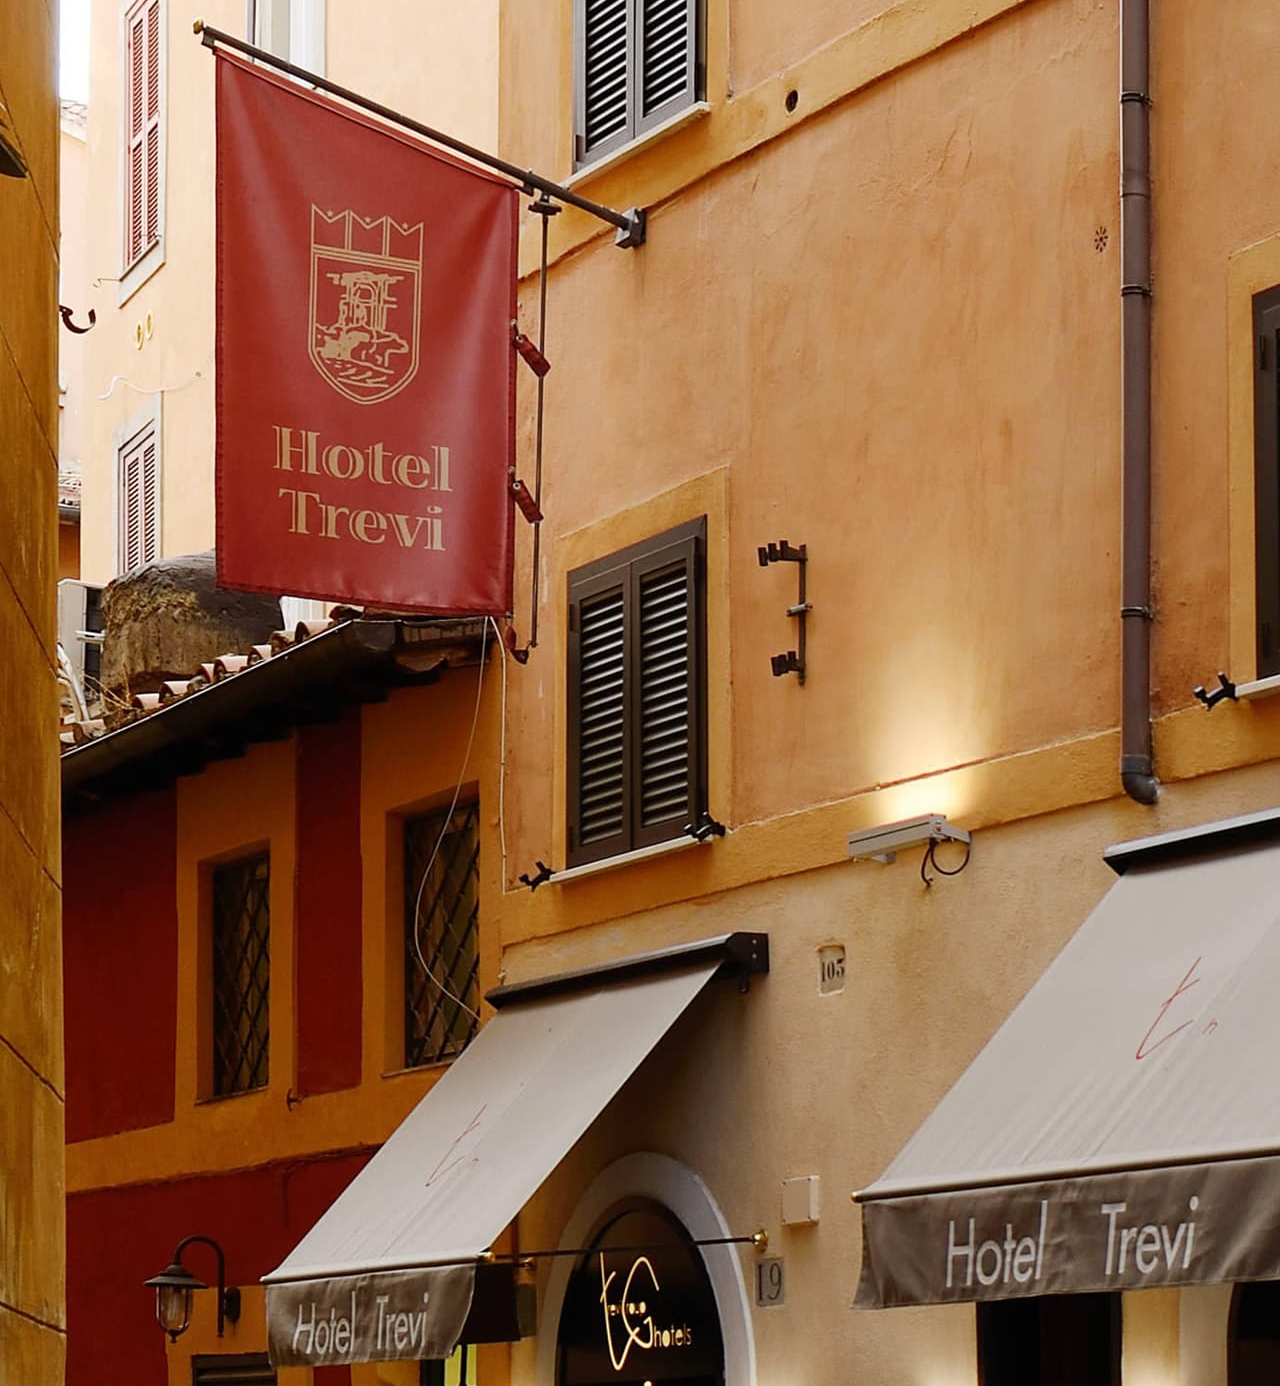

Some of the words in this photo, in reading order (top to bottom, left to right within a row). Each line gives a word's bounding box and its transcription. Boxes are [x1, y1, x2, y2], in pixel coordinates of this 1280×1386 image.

[272, 424, 453, 493] Hotel
[278, 487, 446, 551] Trevi
[945, 1199, 1048, 1288] Hotel
[1101, 1195, 1199, 1275] Trevi
[758, 1262, 783, 1302] 19
[292, 1290, 356, 1356] Hotel
[376, 1292, 429, 1351] Trevi
[654, 1323, 692, 1348] hotels
